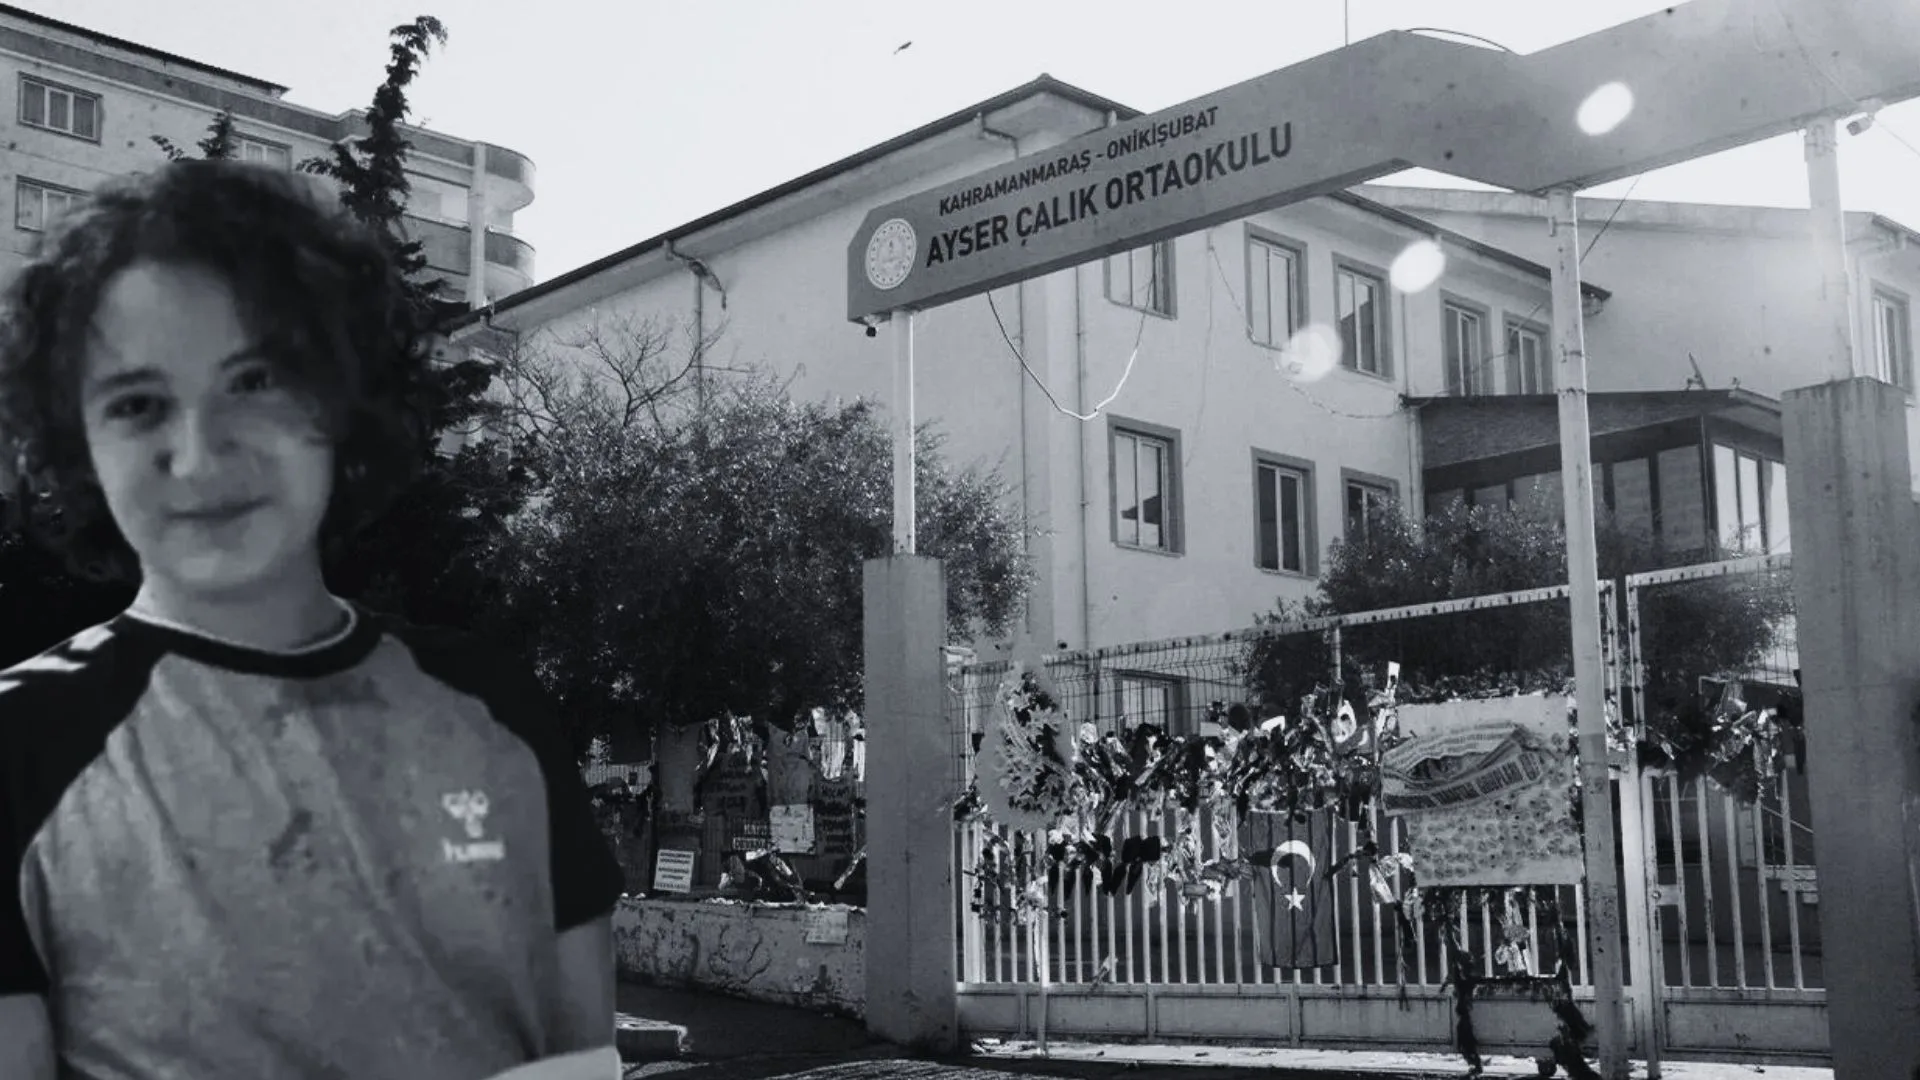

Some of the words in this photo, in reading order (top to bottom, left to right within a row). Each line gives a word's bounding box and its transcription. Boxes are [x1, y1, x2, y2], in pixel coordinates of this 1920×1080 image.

[926, 214, 1009, 268] AYSER
[1016, 183, 1098, 247] ÇALIK
[1105, 121, 1292, 210] ORTAOKULU
[939, 149, 1091, 216] KAHRAMANMARAŞ
[1106, 106, 1219, 160] ONİKİŞUBAT
